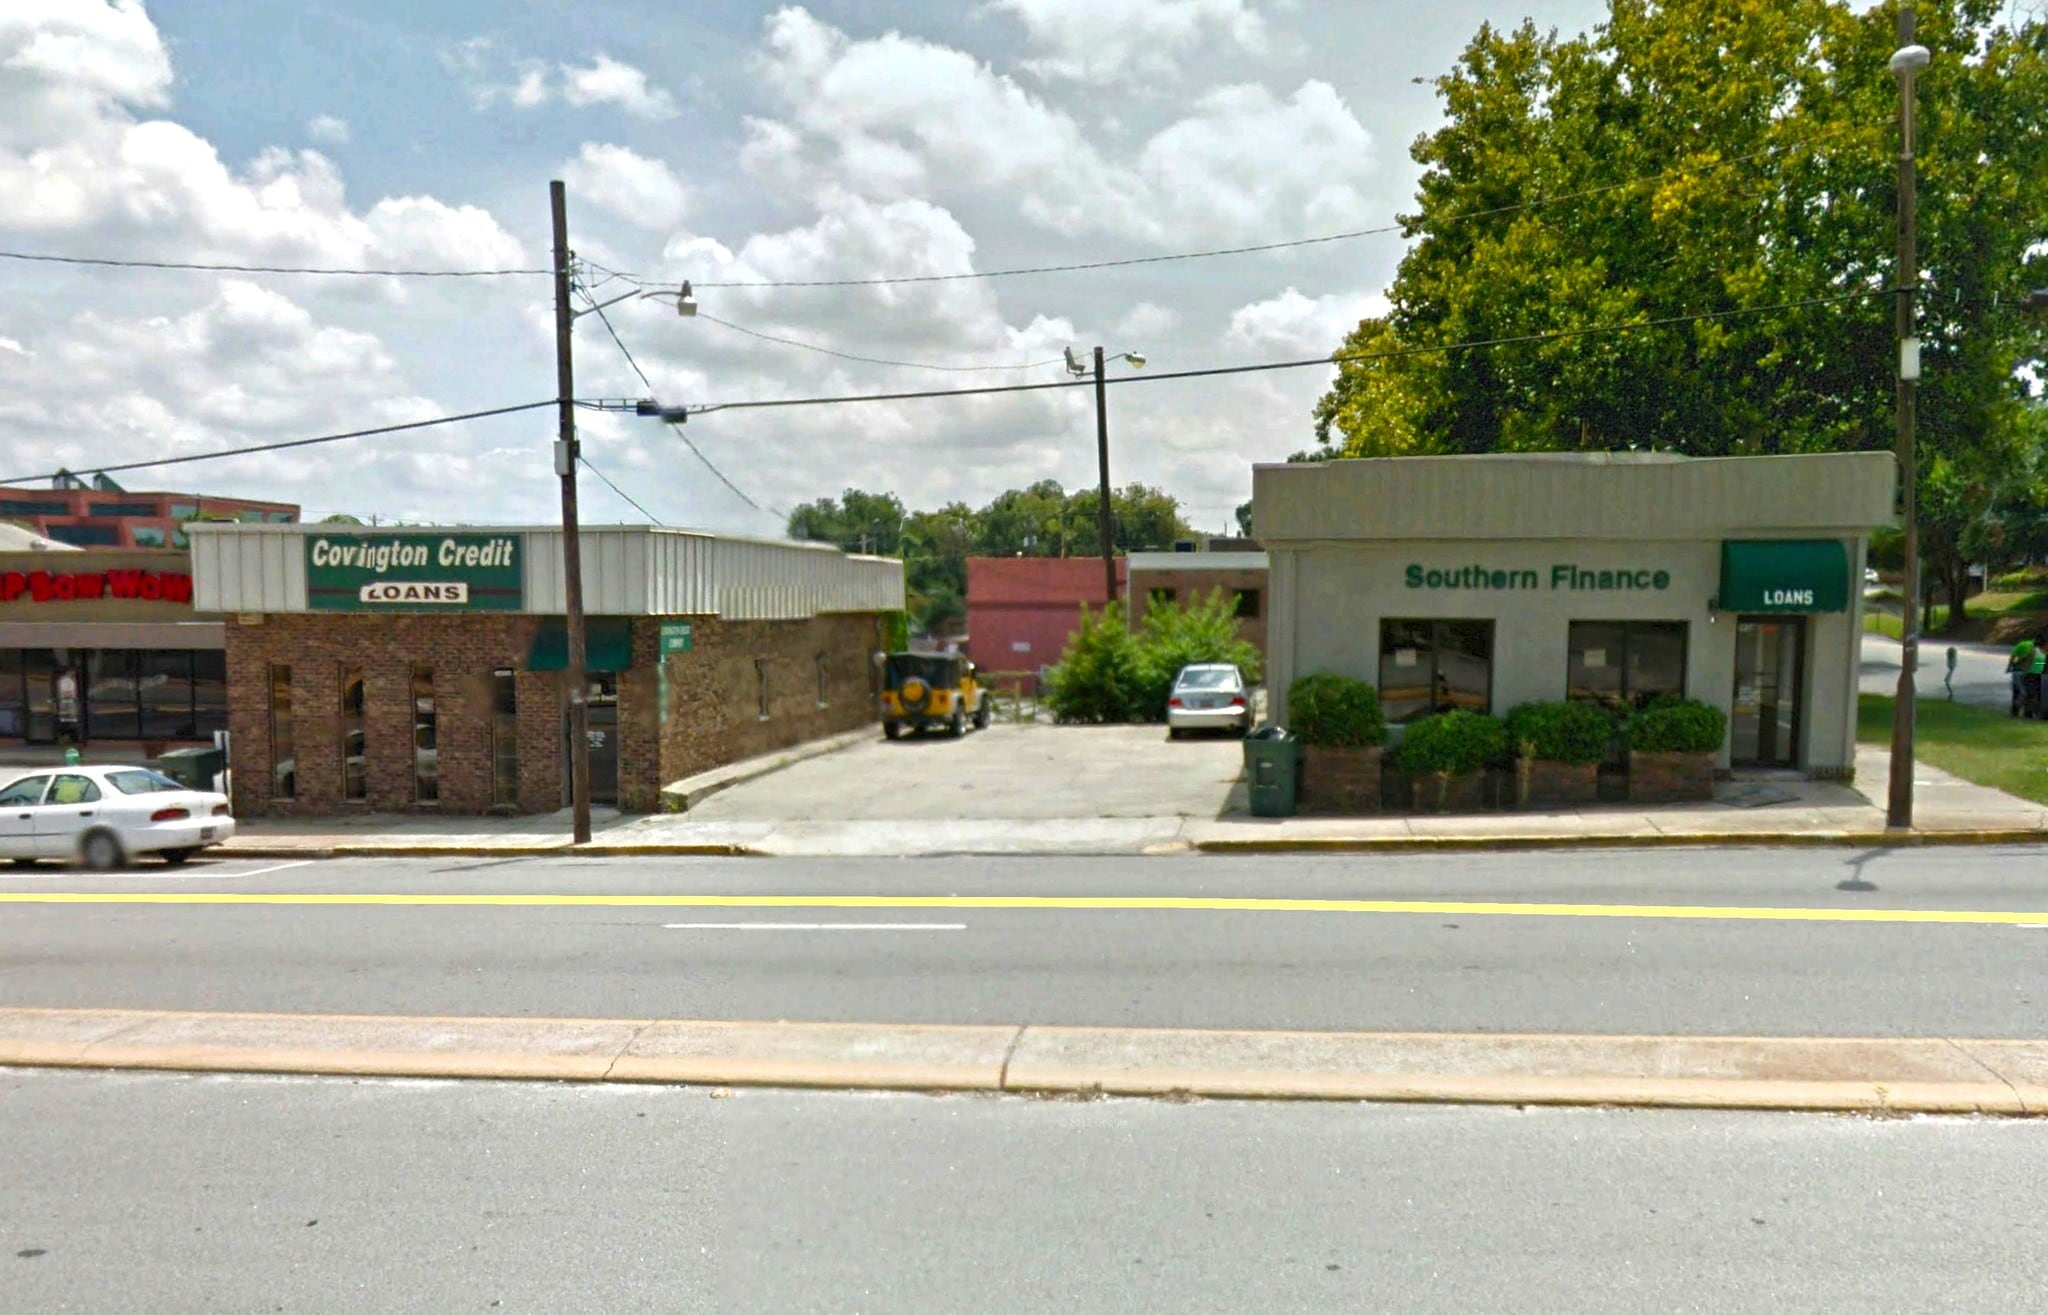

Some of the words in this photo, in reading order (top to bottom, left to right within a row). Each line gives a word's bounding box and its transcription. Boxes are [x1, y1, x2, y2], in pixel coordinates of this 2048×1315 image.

[312, 539, 428, 572] Covington
[438, 539, 514, 567] Credit
[1404, 564, 1538, 589] Southern
[1551, 564, 1671, 589] Finance
[367, 585, 460, 600] LOANS
[1764, 589, 1814, 605] LOANS
